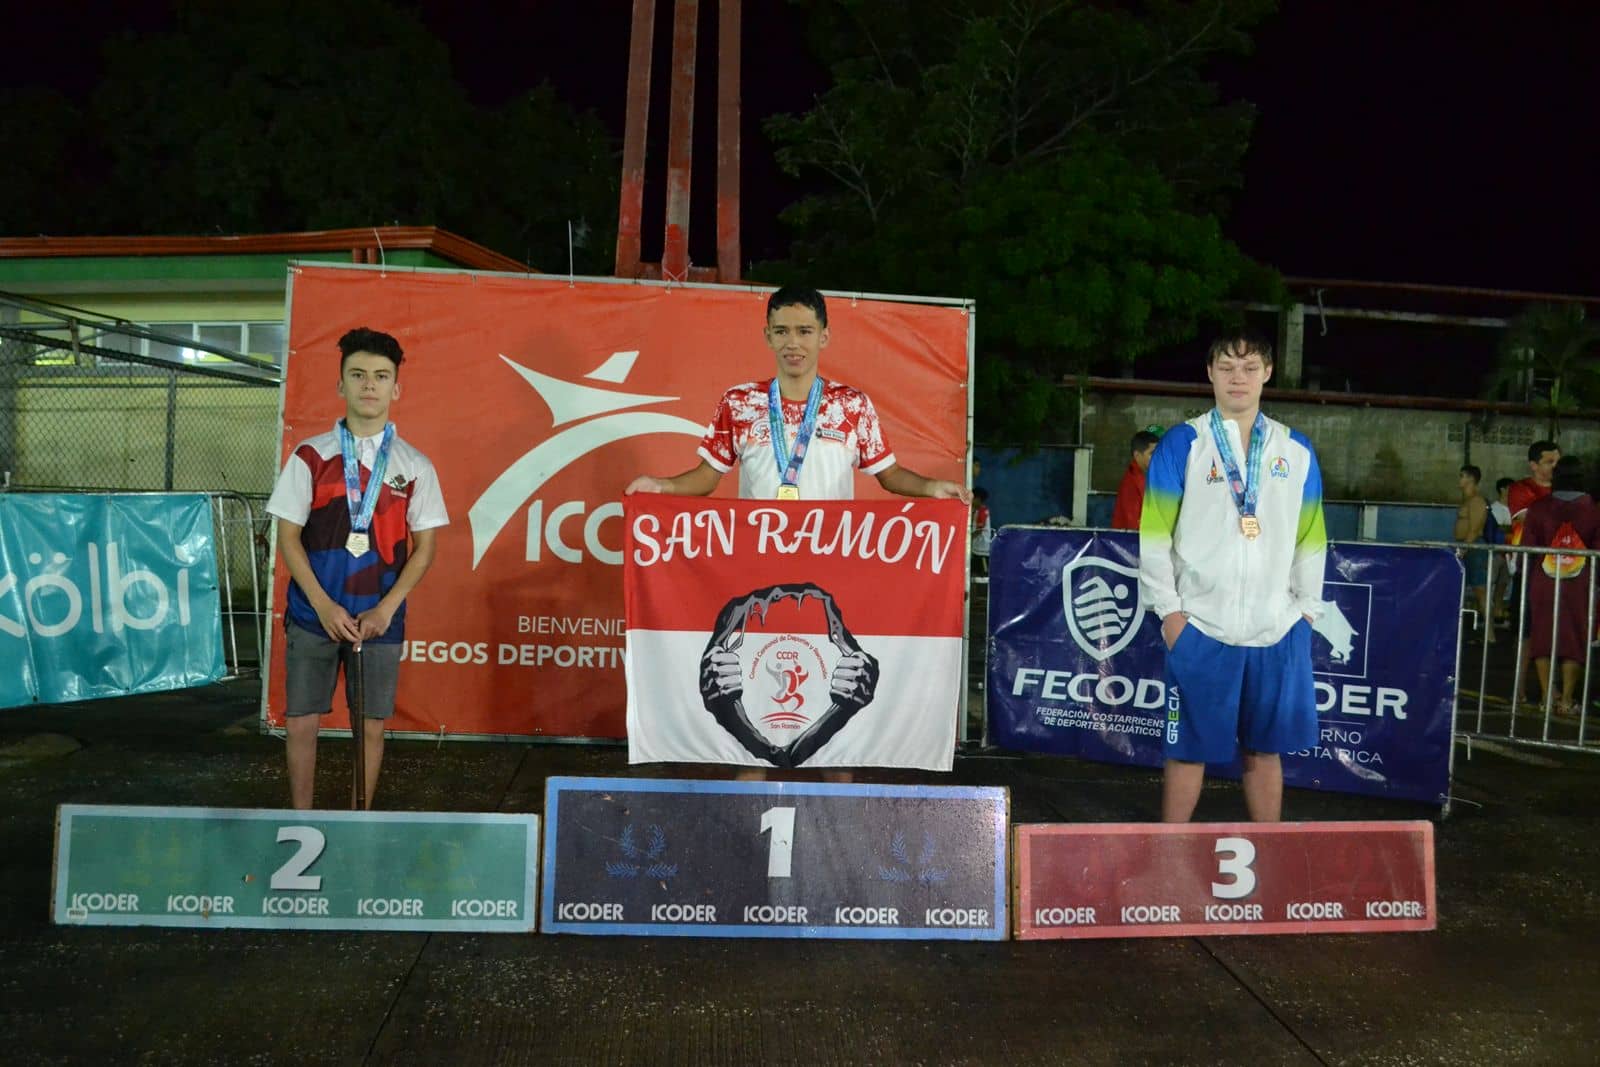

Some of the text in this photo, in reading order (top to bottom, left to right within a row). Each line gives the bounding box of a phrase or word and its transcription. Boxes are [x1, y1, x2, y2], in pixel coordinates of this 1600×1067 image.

[632, 502, 955, 574] SAN RAMÓN
[1036, 706, 1091, 720] FEDERACIÓN
[1044, 716, 1161, 737] DE DEPORTES ACUÁTICOS
[1167, 685, 1180, 744] GRECIA
[270, 826, 326, 891] 2
[759, 807, 797, 878] 1
[1211, 837, 1256, 899] 3
[72, 893, 518, 918] ICODER ICODER ICODER ICODER ICODER
[559, 903, 989, 927] ICODER ICODER ICODER ICODER ICODER
[1035, 901, 1421, 925] ICODER ICODER ICODER ICODER ICODER
